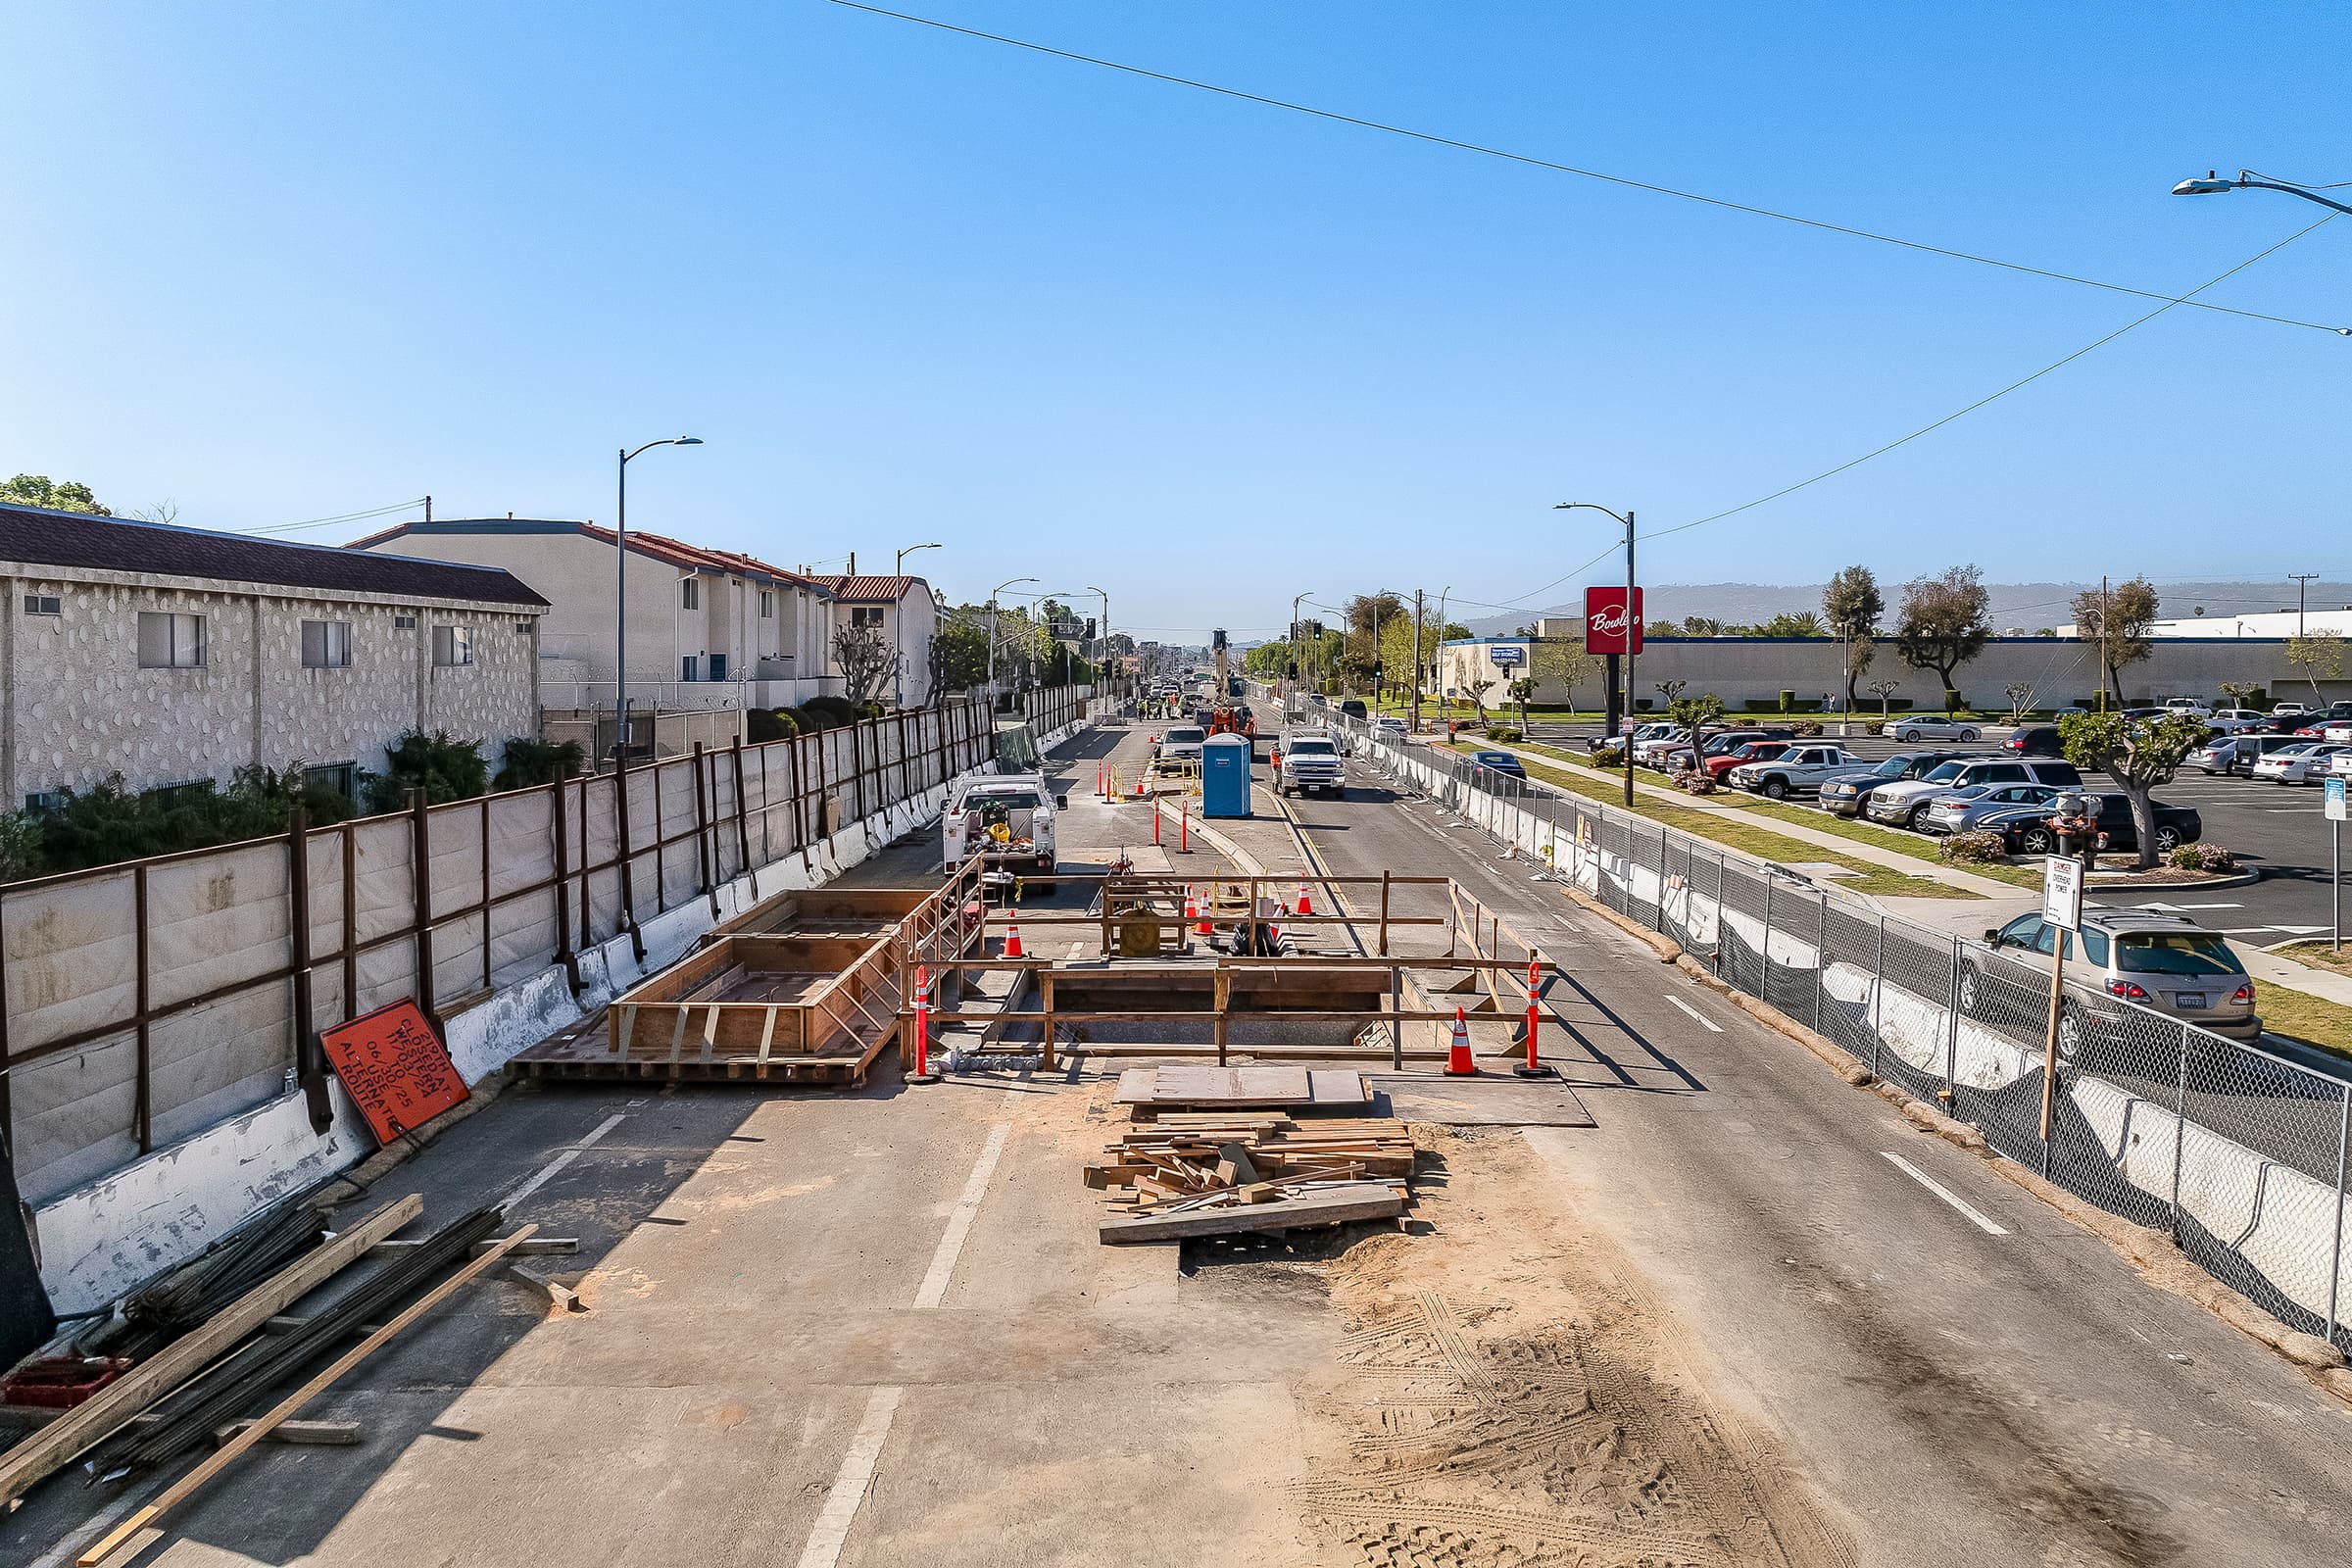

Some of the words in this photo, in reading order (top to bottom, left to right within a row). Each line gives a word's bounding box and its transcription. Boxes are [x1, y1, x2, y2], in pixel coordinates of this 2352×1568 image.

[1590, 609, 1640, 631] Bowleo
[2053, 860, 2072, 873] DANGER
[2054, 883, 2068, 894] POWER
[367, 1041, 413, 1108] 06/30/25
[386, 1033, 431, 1098] 11/03/24
[390, 1060, 406, 1079] TO
[395, 1026, 439, 1094] WESTERN
[401, 1018, 438, 1072] CLOSED
[434, 1075, 452, 1095] AT
[418, 1032, 450, 1073] 219TH
[340, 1042, 399, 1127] ALTERNATE
[340, 1064, 377, 1113] ROUTE
[368, 1064, 390, 1094] USE
